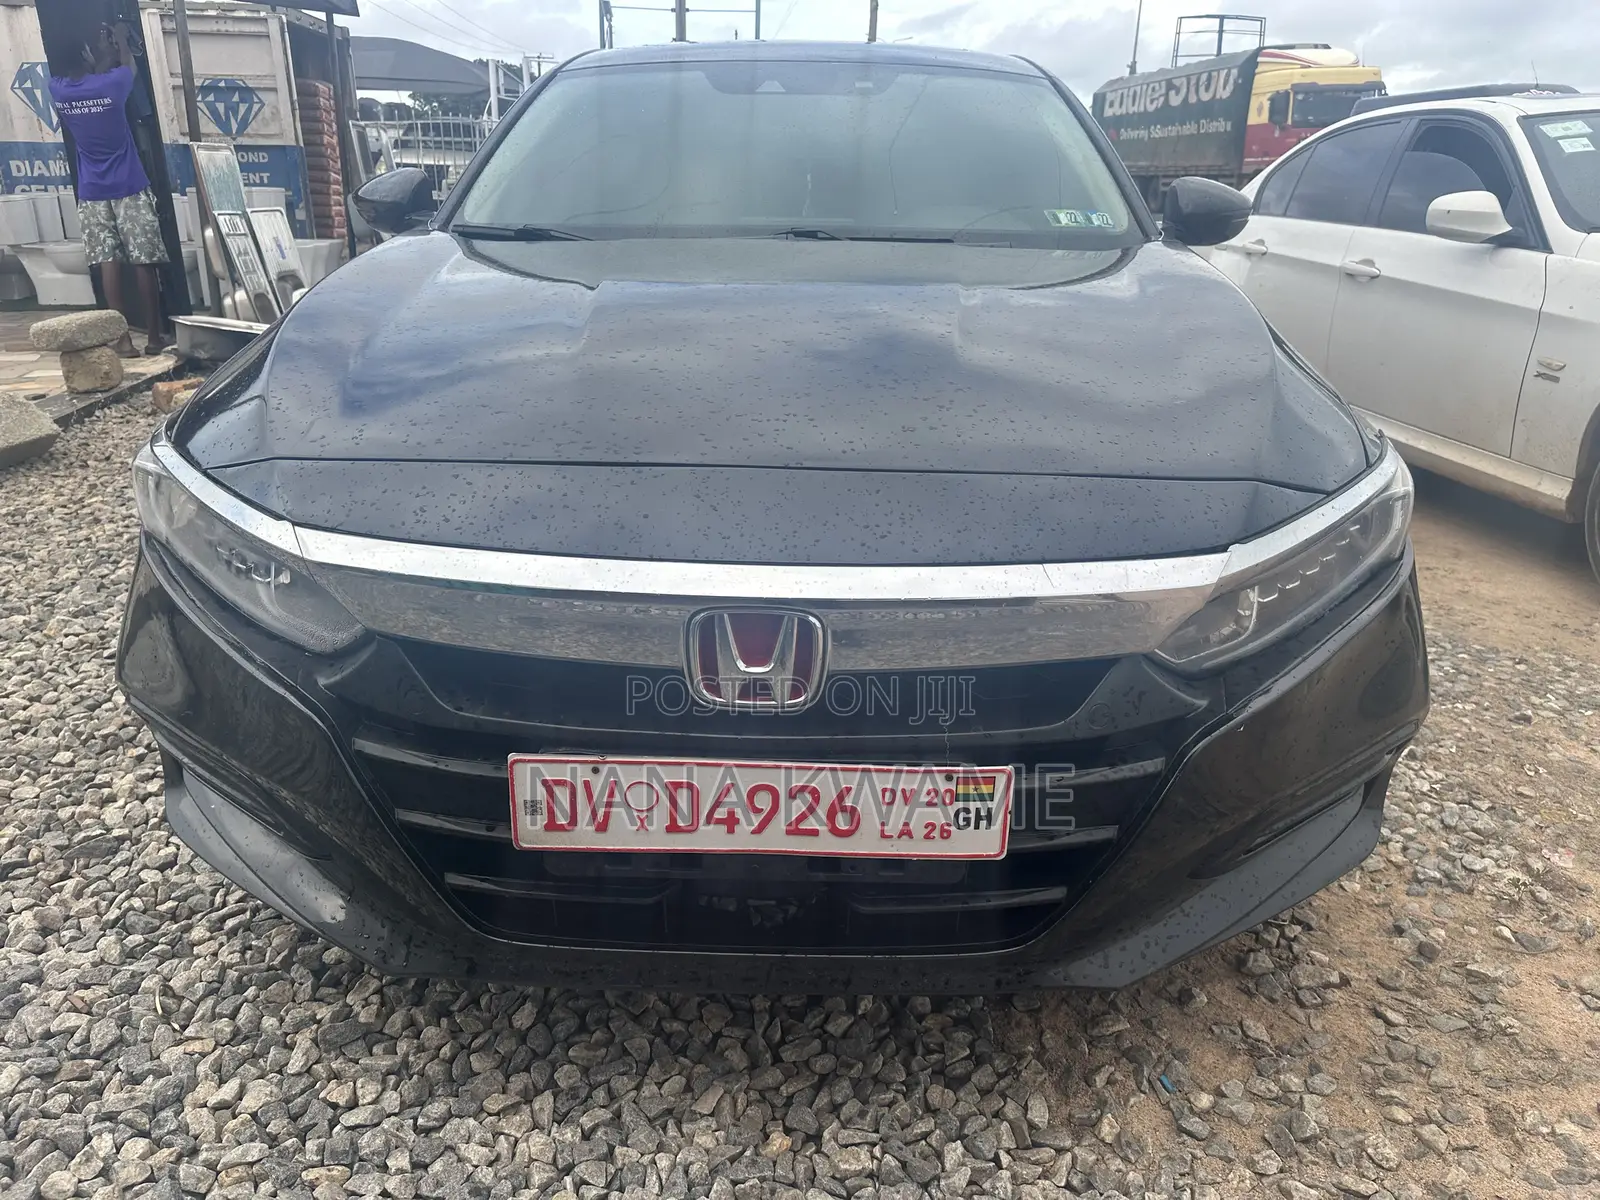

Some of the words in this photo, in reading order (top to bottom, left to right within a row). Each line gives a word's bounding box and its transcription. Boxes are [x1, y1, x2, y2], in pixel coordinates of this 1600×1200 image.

[237, 151, 269, 163] OND
[881, 787, 914, 807] DV
[952, 807, 994, 831] GH
[879, 821, 914, 839] LA
[923, 822, 953, 840] 26
